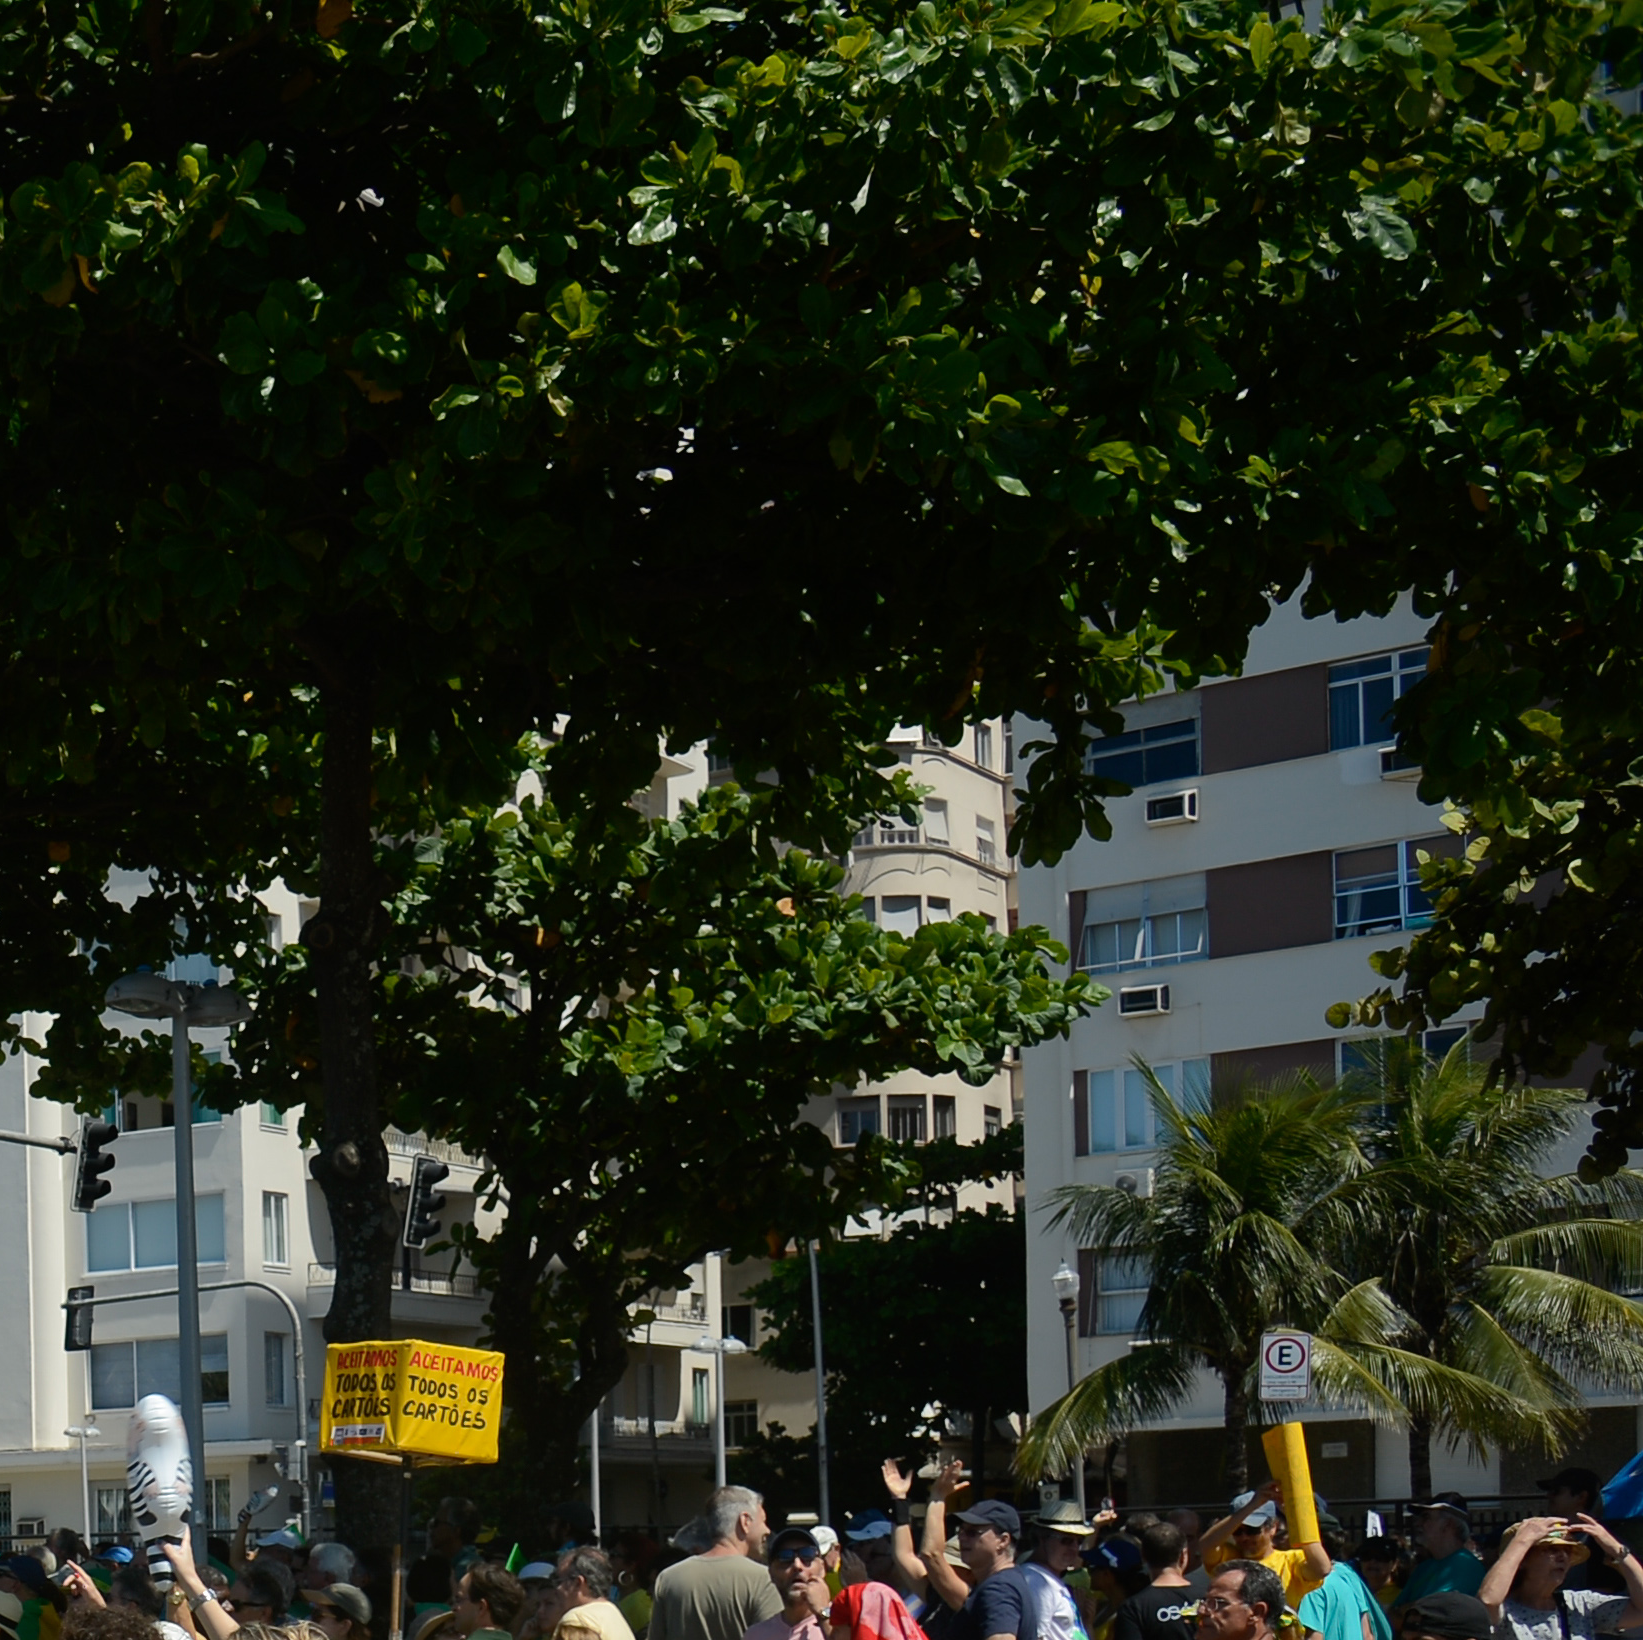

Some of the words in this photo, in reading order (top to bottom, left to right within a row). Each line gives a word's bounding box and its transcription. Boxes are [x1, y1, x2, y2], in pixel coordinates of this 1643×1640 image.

[336, 1349, 398, 1370] ACEITAMOS
[1278, 1345, 1293, 1366] E
[409, 1350, 500, 1383] ACEITAMOS
[335, 1373, 377, 1393] TODOS
[380, 1372, 396, 1392] OS
[407, 1374, 458, 1399] TODOS
[467, 1388, 489, 1406] OS
